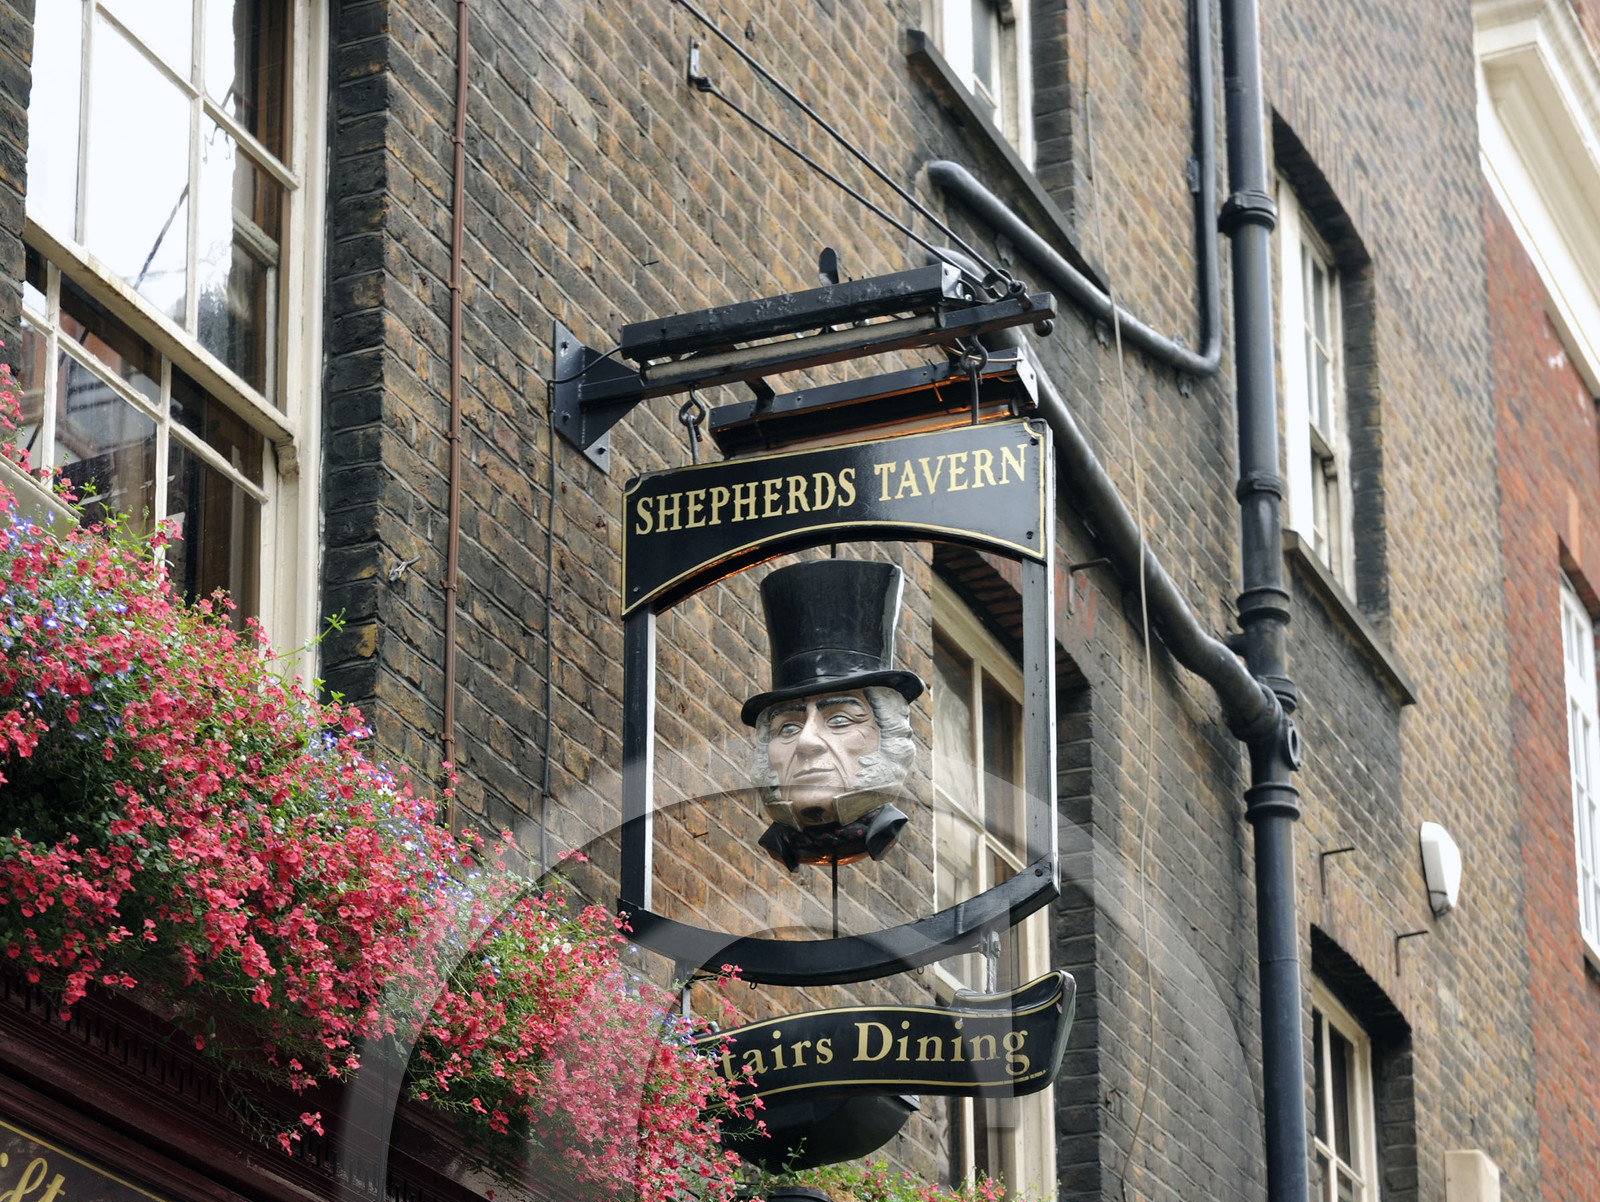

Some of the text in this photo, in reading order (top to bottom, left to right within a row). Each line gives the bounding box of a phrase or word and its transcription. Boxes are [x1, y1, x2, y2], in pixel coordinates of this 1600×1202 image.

[635, 443, 1029, 535] SHEPHERDS TAVERN
[707, 1020, 1031, 1080] tairs Dining
